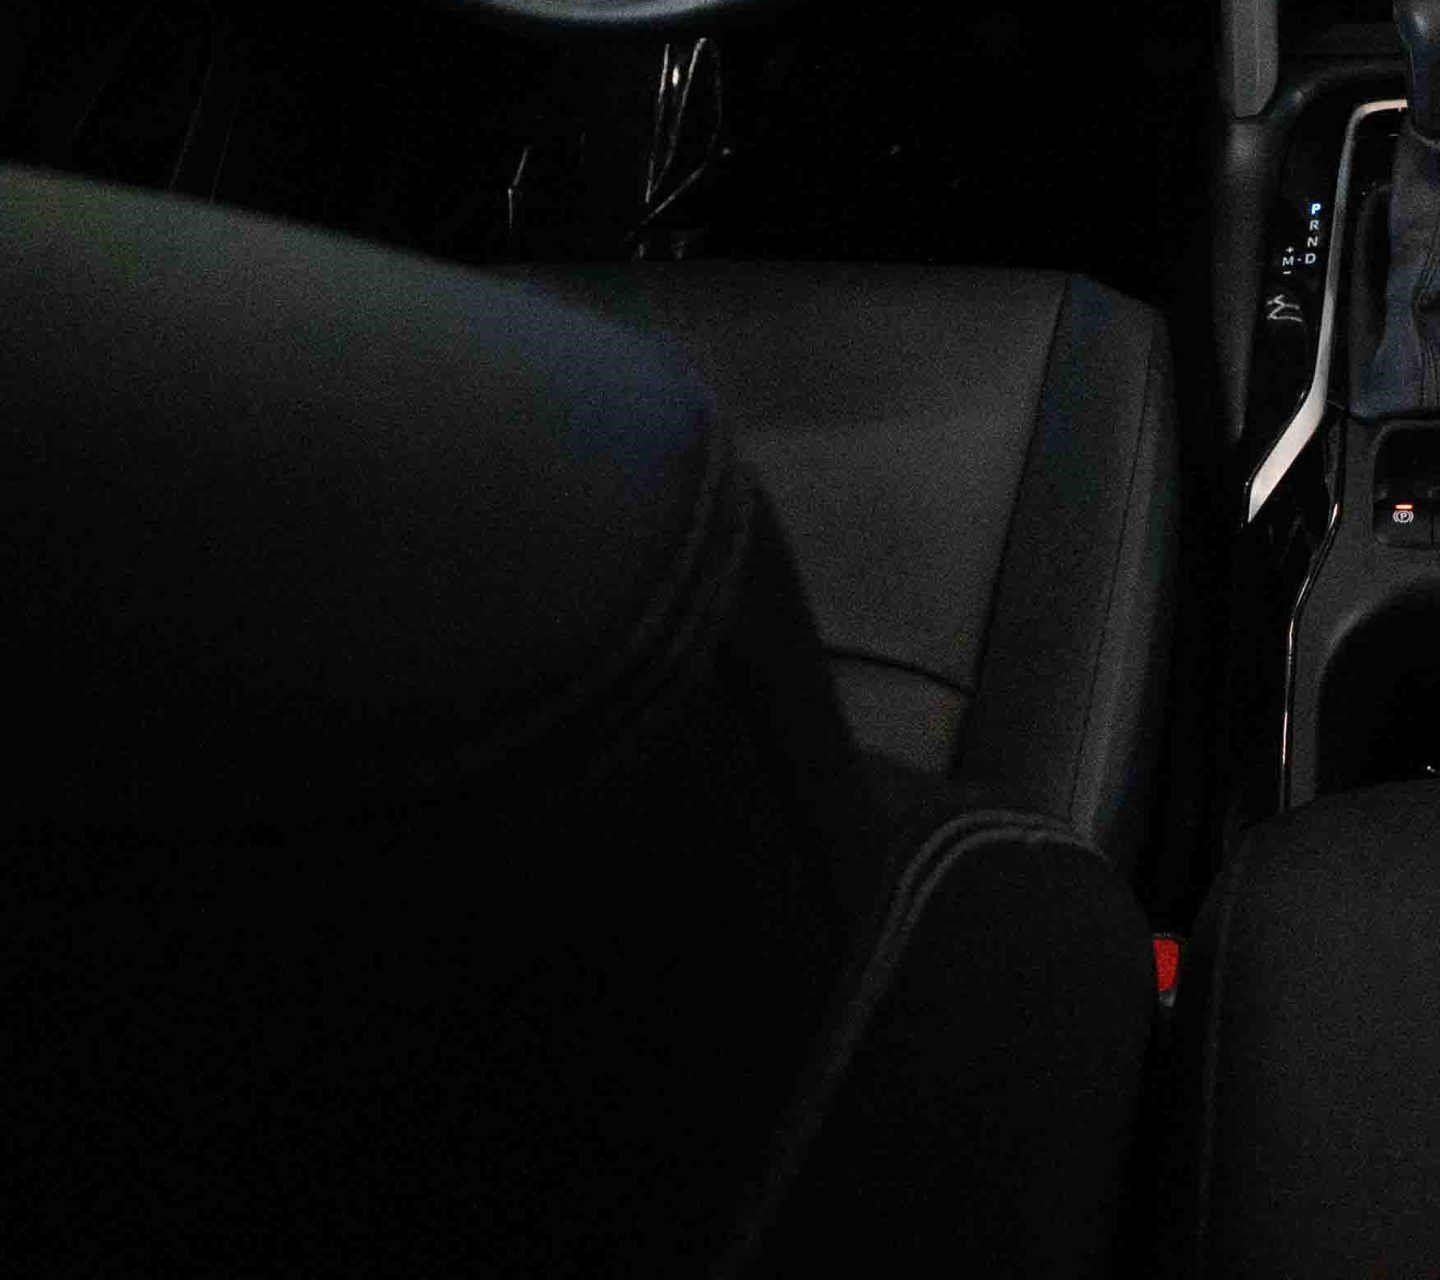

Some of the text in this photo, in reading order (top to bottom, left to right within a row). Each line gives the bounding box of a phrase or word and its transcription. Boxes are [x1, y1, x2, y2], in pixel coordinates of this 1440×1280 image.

[1311, 202, 1321, 215] P
[1309, 220, 1319, 231] R
[1307, 236, 1318, 248] N
[1282, 255, 1294, 266] M
[1305, 253, 1316, 264] D
